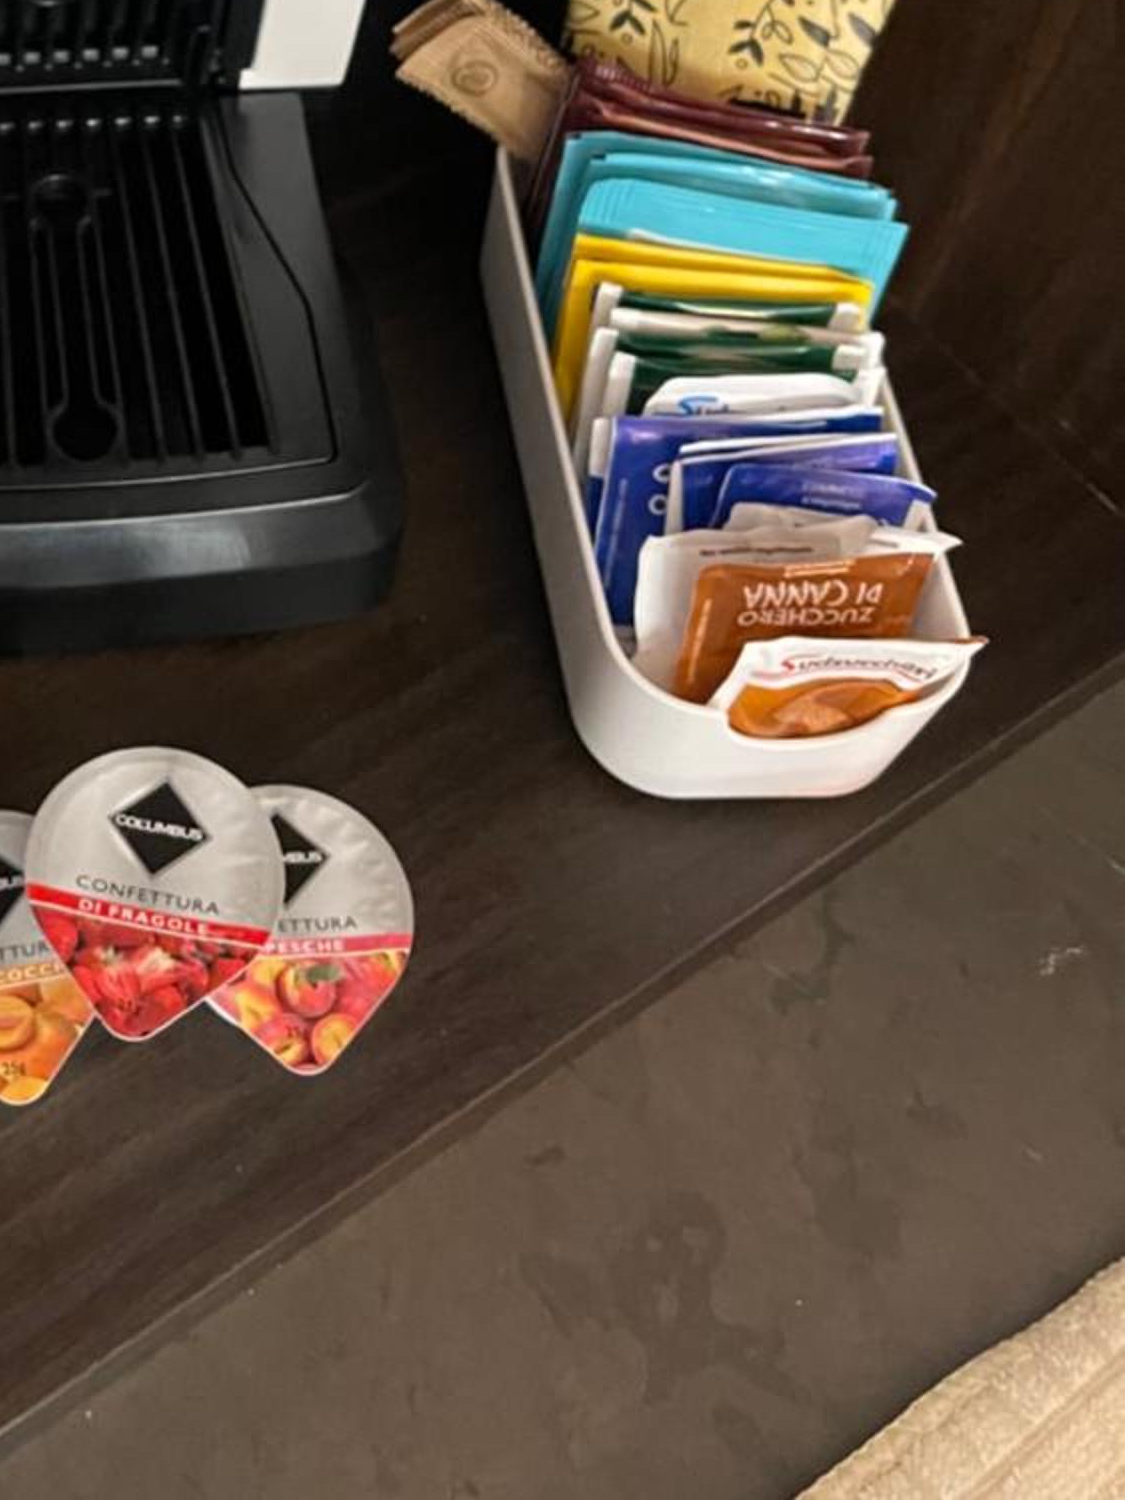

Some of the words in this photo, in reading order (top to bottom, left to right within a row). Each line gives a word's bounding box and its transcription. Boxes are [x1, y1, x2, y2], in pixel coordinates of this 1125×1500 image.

[743, 579, 849, 608] CANNA
[856, 582, 883, 605] DI
[737, 607, 875, 627] ZUCCHERO
[115, 813, 204, 842] COLUMBUS
[75, 875, 220, 916] CONFETTURA
[79, 899, 101, 916] DI
[107, 904, 209, 935] FRAGOLE
[278, 915, 357, 933] ETTURA
[265, 939, 345, 953] PESCHE
